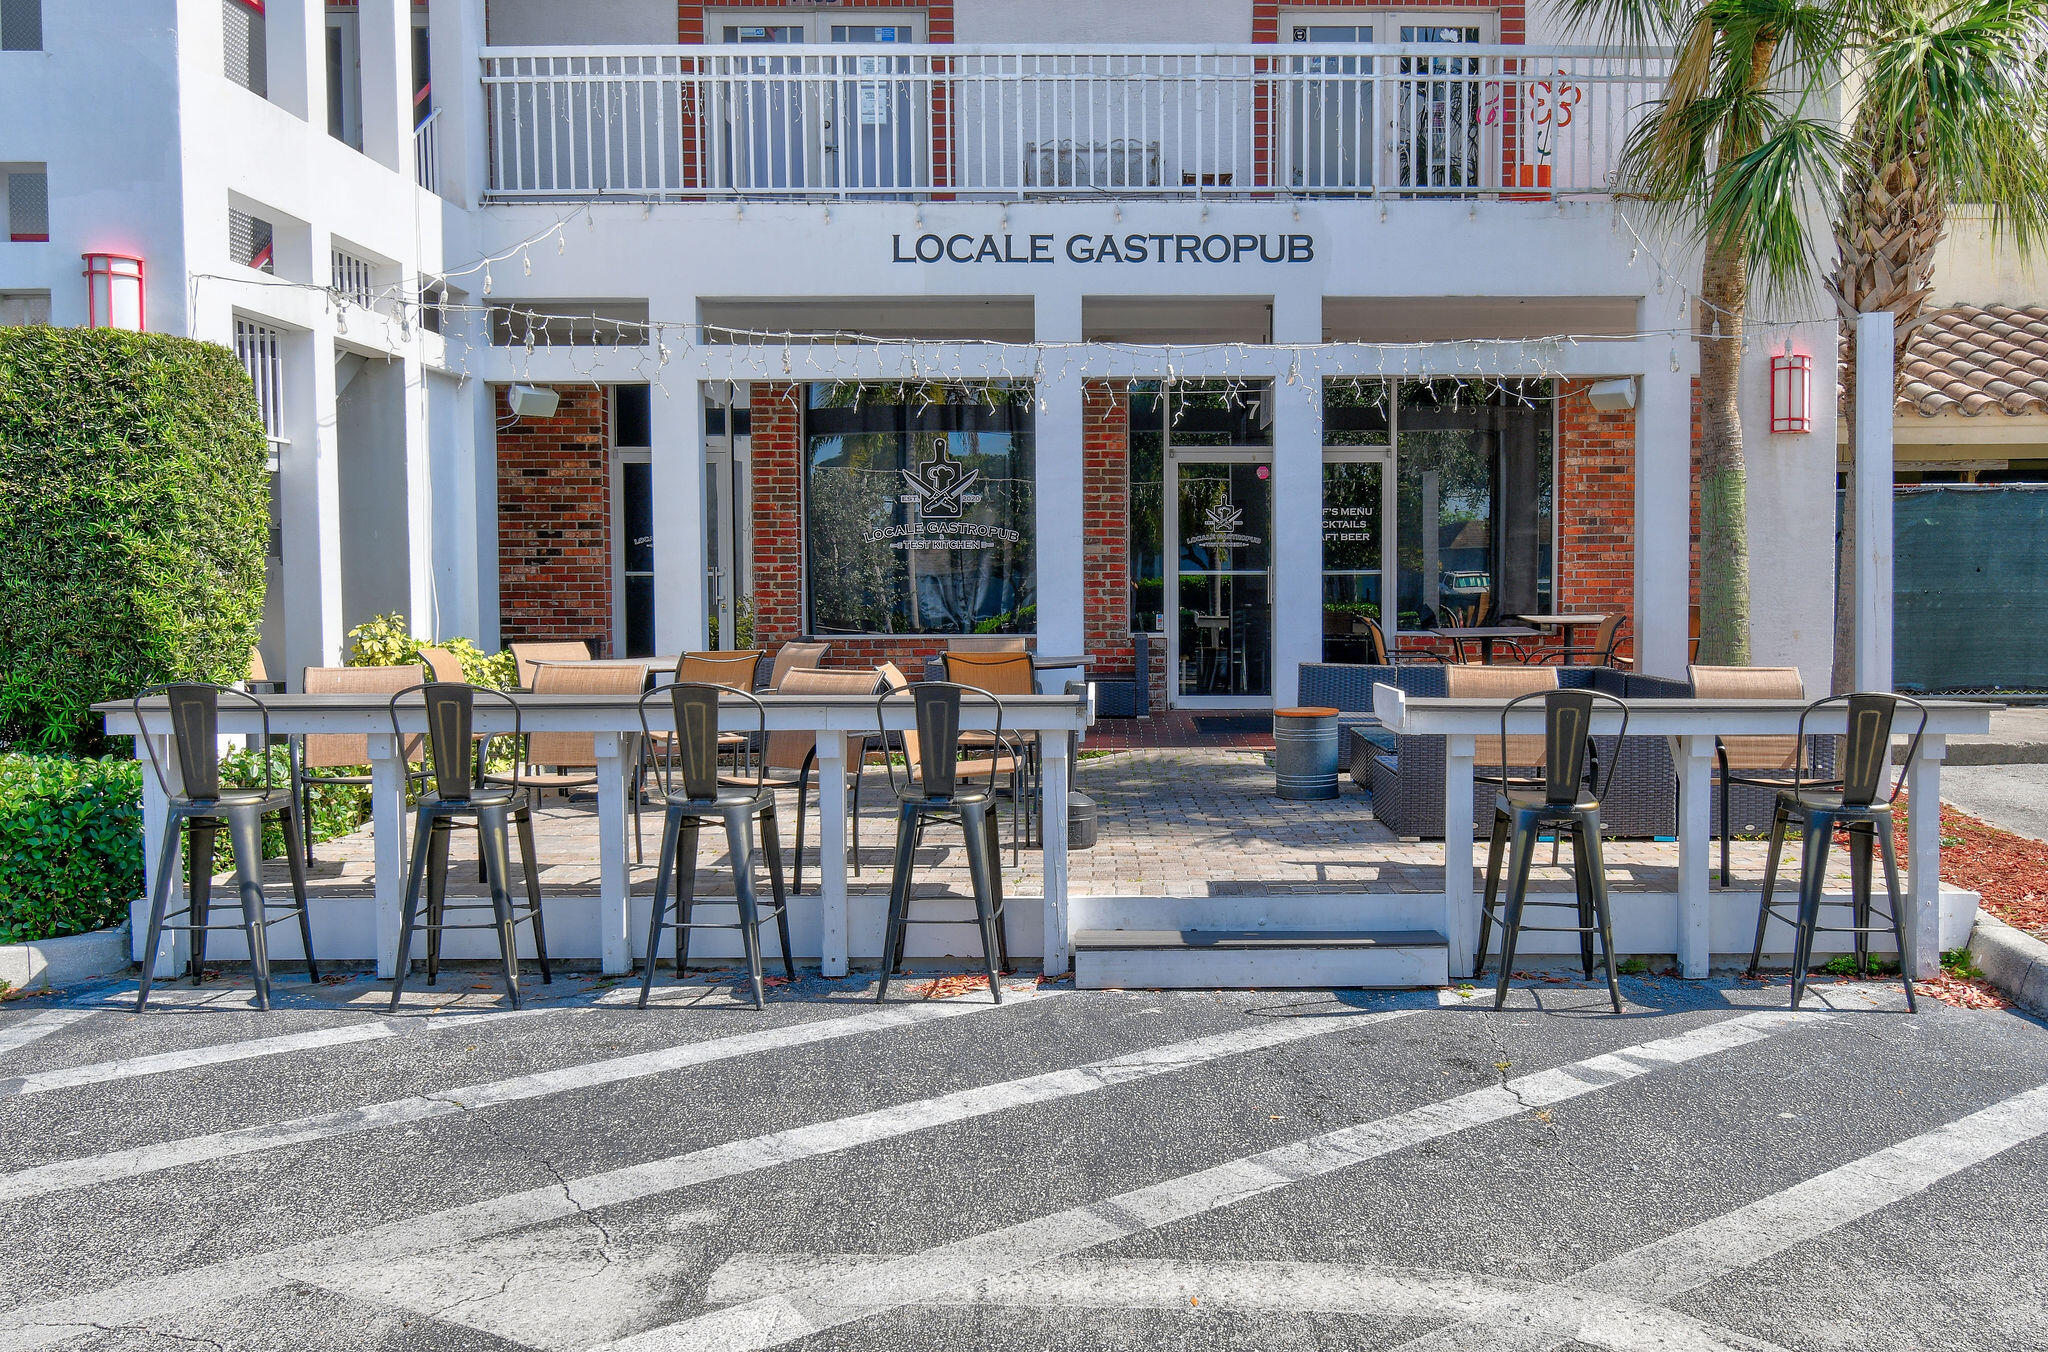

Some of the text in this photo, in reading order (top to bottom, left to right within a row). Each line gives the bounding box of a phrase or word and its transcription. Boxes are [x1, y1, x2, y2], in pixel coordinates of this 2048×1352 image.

[892, 234, 1315, 263] LOCALE GASTROPUB
[1246, 400, 1260, 420] 7
[1340, 507, 1373, 516] MENU
[863, 521, 1020, 544] LOCALE GASTROPUB
[1340, 533, 1370, 541] BEER
[902, 539, 981, 550] TEST KITCHEN
